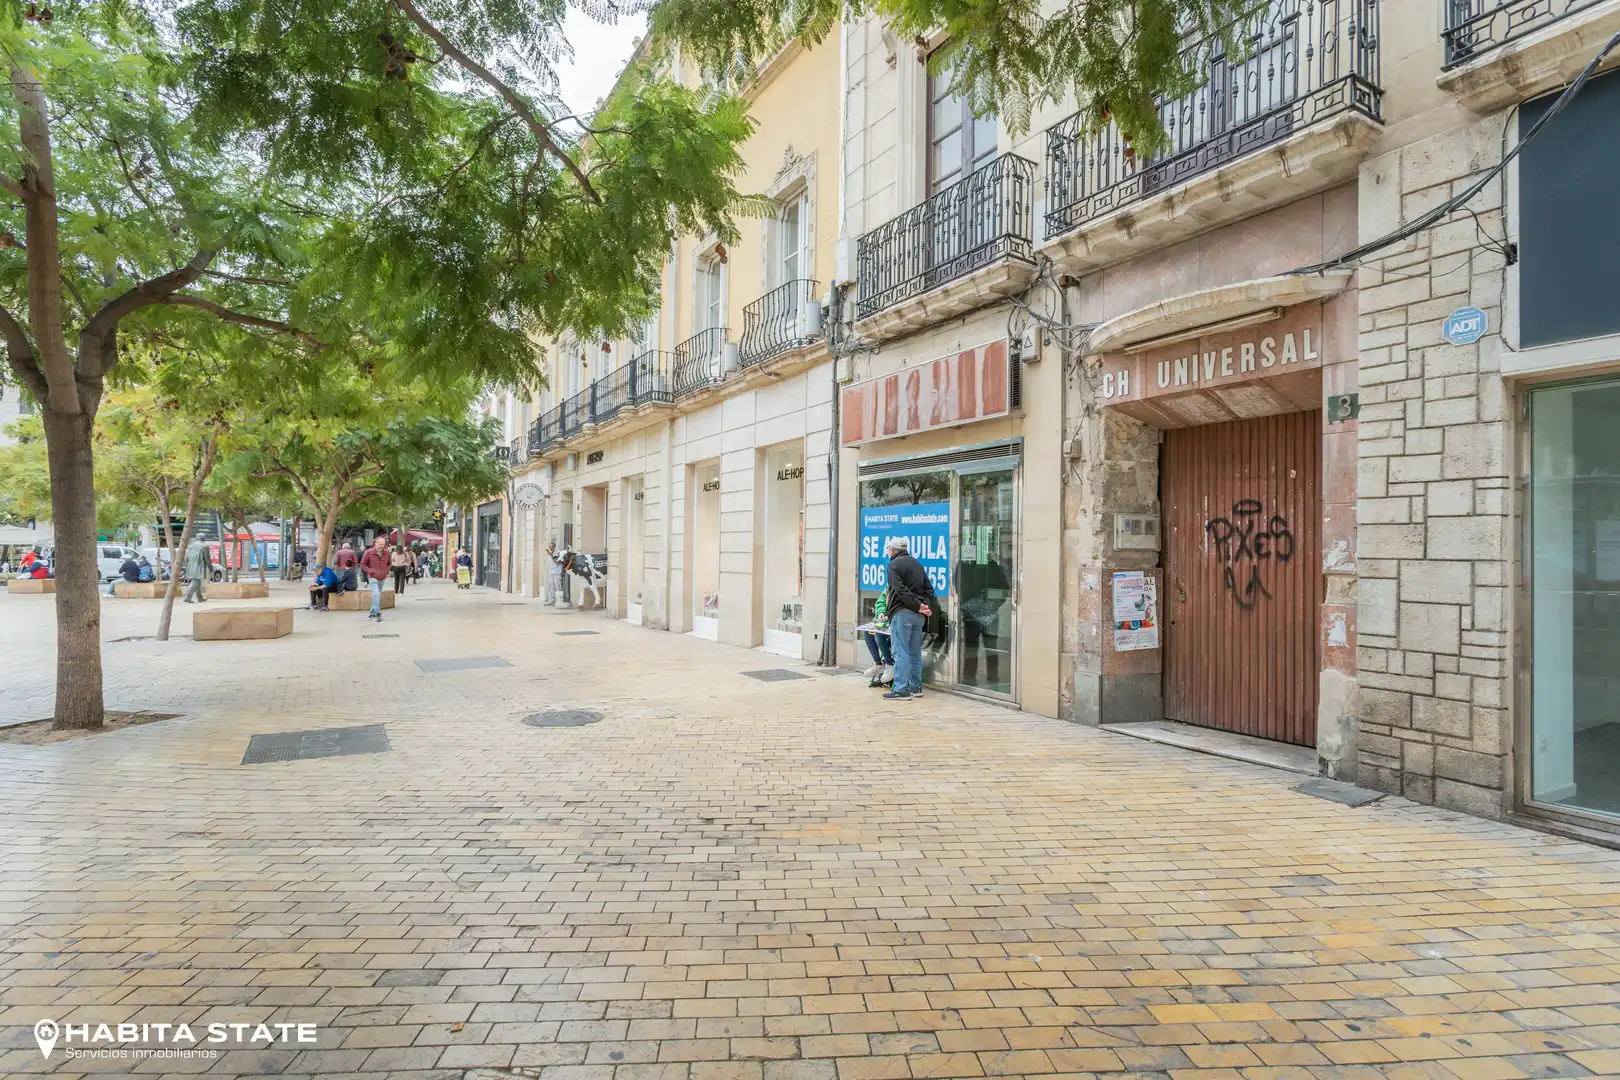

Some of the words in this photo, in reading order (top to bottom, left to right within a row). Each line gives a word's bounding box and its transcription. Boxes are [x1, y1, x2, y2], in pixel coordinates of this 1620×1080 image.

[1450, 318, 1480, 334] ADT
[1103, 370, 1129, 399] CH
[1157, 328, 1318, 388] UNIVERSAL
[1339, 396, 1352, 417] 3
[777, 467, 804, 481] ALE-HOP
[867, 515, 884, 523] HABITA
[884, 514, 899, 522] STATE
[862, 535, 879, 558] SE
[882, 535, 947, 560] AUILA
[862, 563, 885, 586] 606
